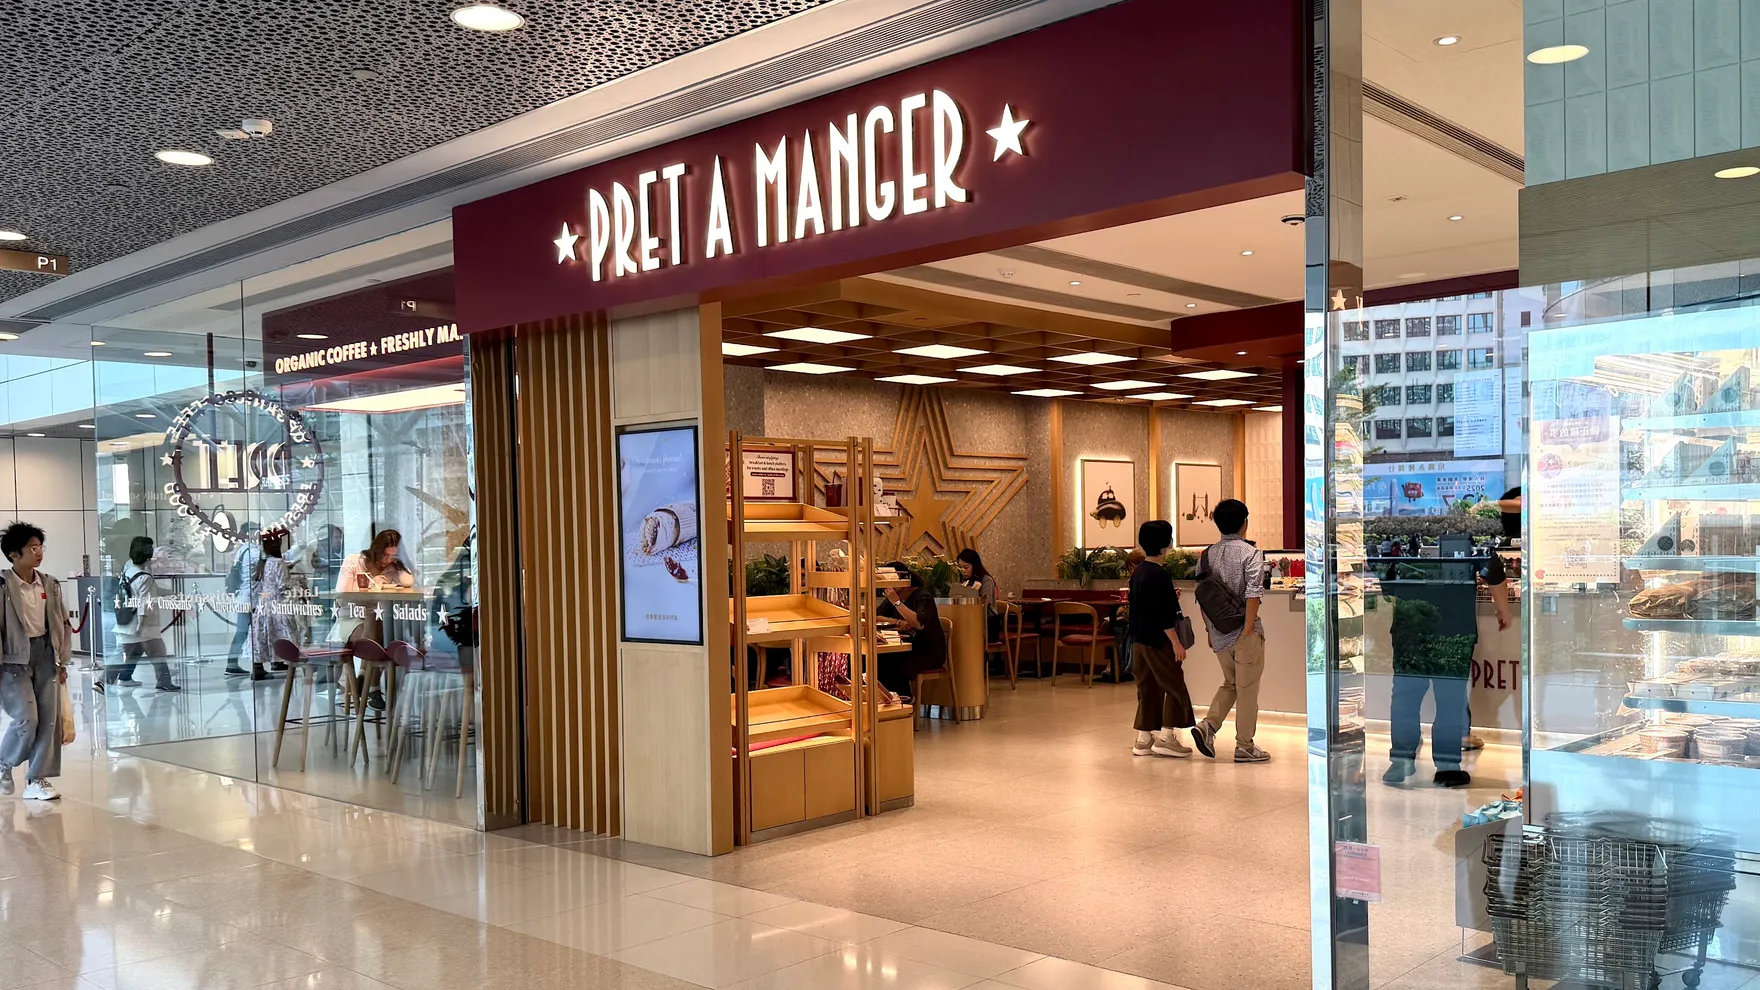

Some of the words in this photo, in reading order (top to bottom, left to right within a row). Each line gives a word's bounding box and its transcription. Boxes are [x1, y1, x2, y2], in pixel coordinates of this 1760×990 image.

[588, 162, 686, 282] PRET
[705, 154, 735, 259] A
[754, 88, 970, 248] MANGER
[37, 256, 57, 271] P1
[275, 349, 326, 375] ORGANIC
[326, 341, 368, 364] COFFEE
[380, 327, 435, 355] FRESHLY
[436, 323, 464, 345] MA
[271, 601, 323, 617] Sandwiches
[347, 602, 366, 618] Tea
[392, 603, 429, 621] Salads
[1471, 659, 1520, 690] PRET
